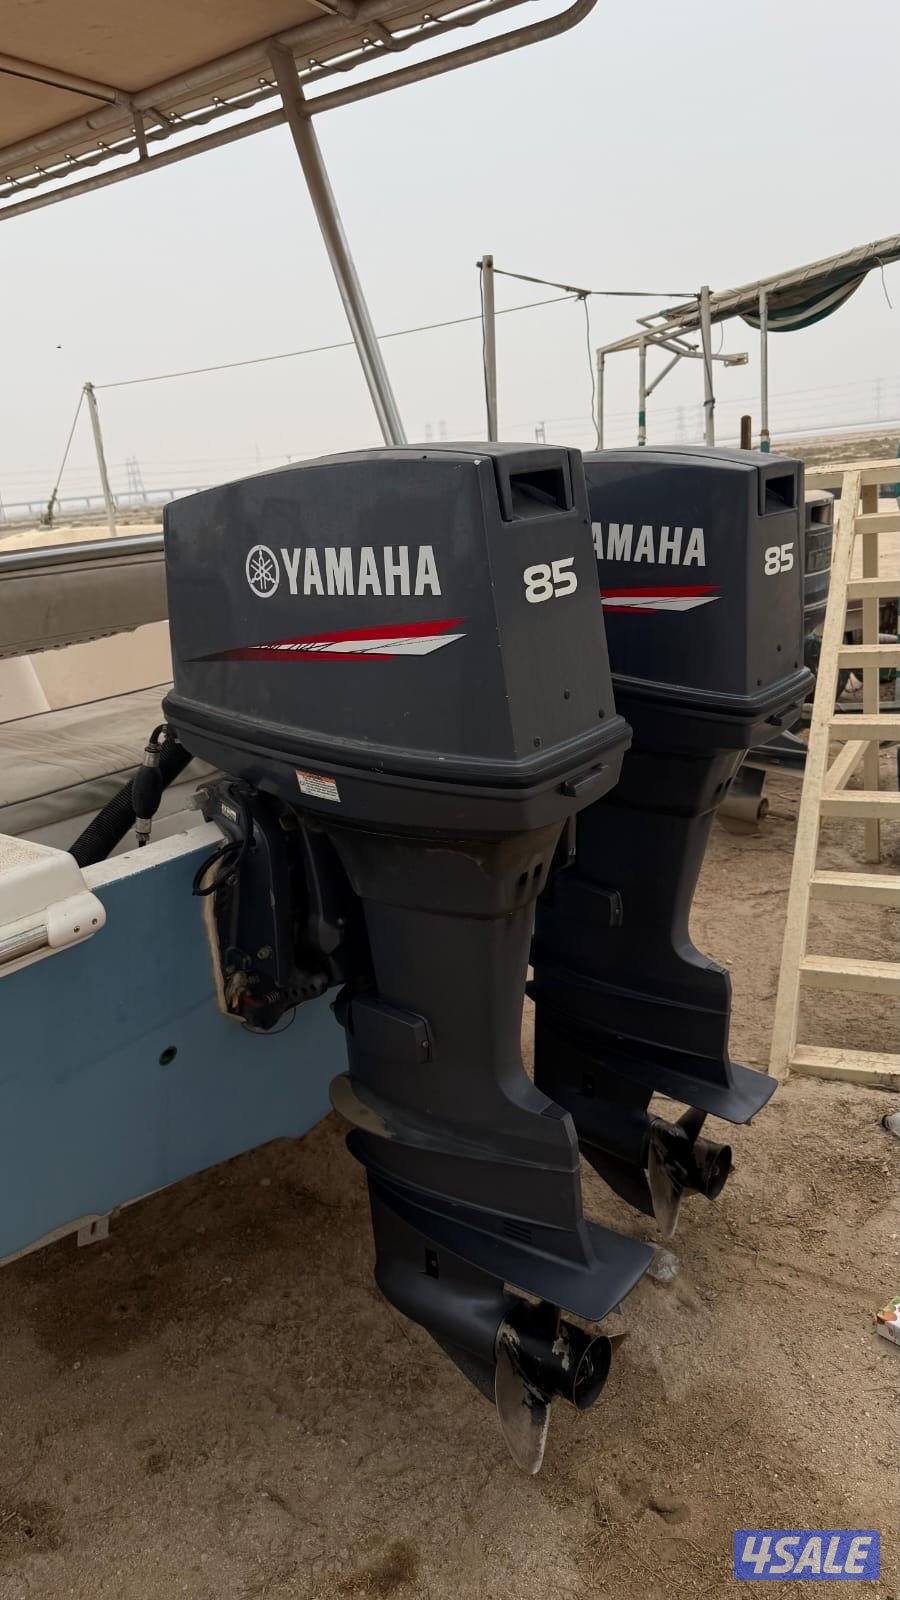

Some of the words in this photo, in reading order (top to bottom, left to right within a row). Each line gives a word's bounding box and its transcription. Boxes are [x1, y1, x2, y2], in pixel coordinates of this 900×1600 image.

[591, 522, 706, 567] AMAHA
[764, 542, 794, 576] 85
[281, 545, 442, 596] YAMAHA
[523, 557, 578, 604] 85
